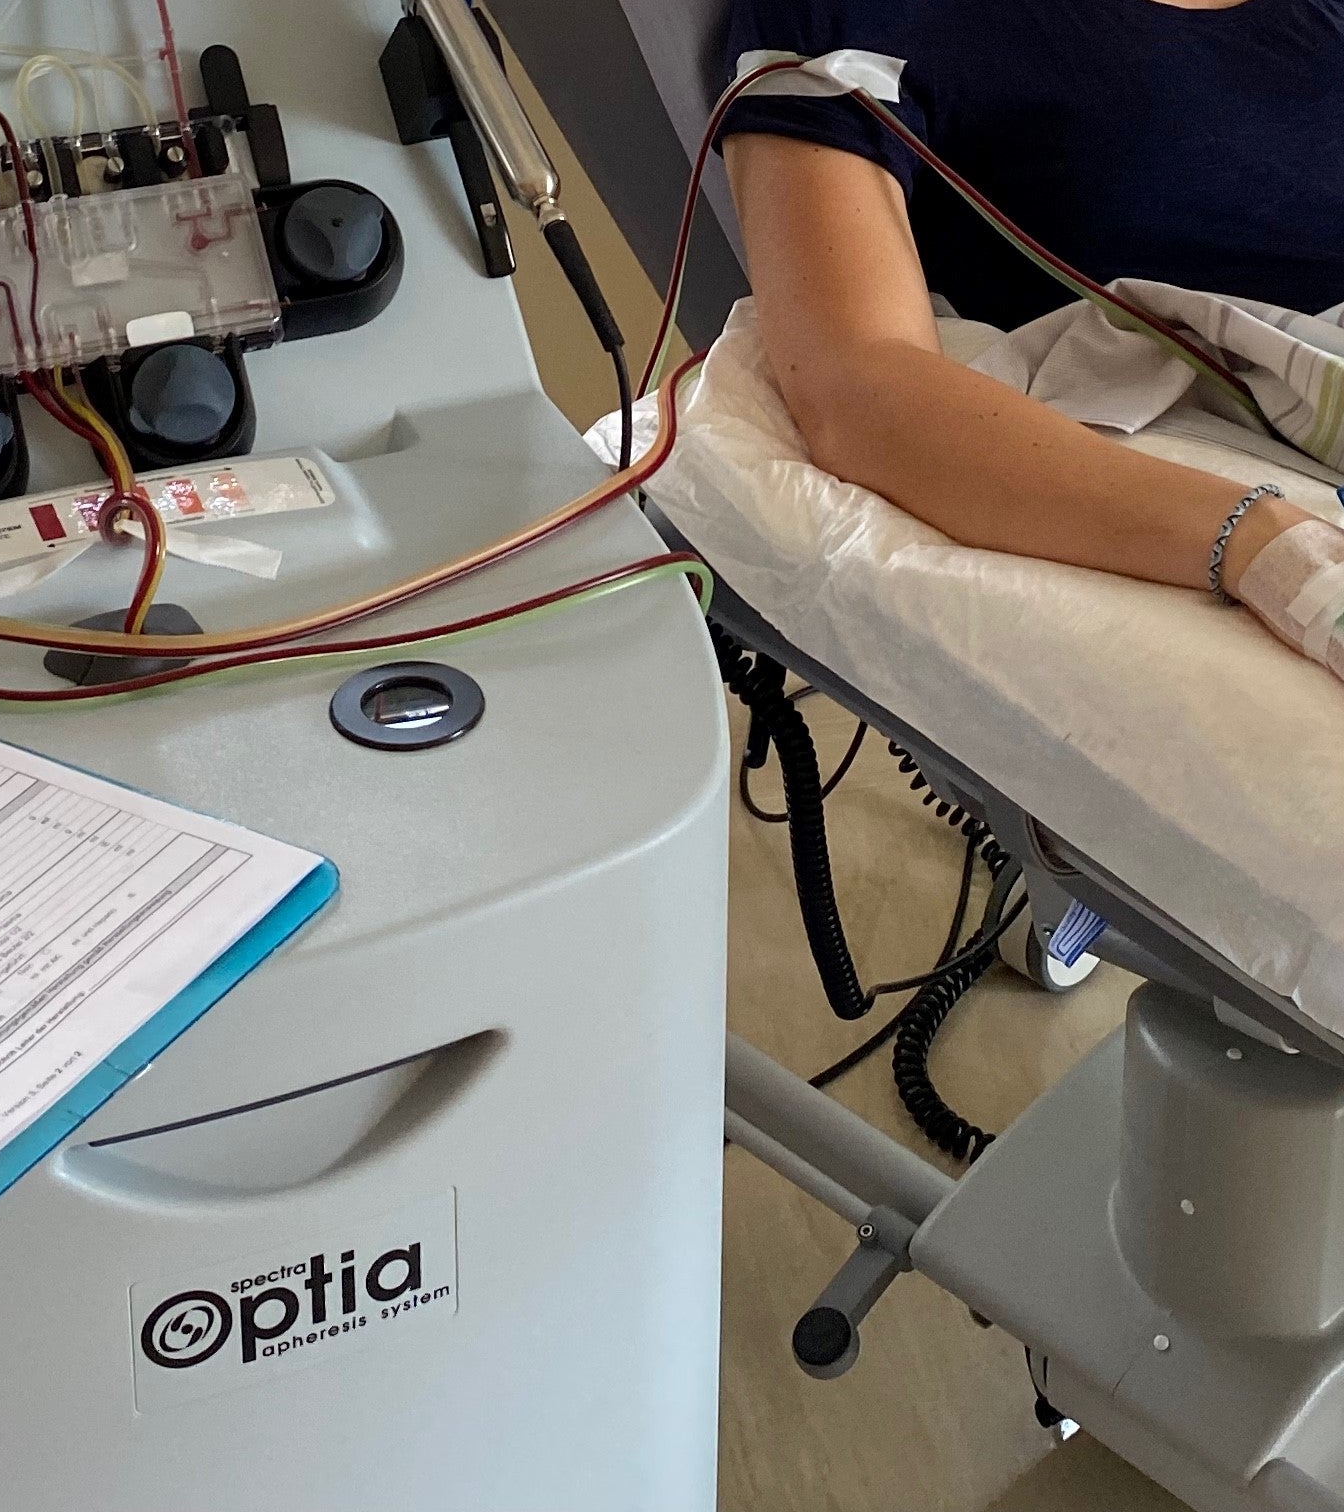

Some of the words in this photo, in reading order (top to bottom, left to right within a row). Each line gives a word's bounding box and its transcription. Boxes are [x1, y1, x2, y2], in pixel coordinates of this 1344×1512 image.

[2, 1096, 30, 1117] Version
[36, 1074, 57, 1089] Seite
[63, 1056, 77, 1068] von
[141, 1242, 423, 1369] Optia
[230, 1262, 307, 1294] spectra
[262, 1315, 367, 1358] apheresis
[380, 1284, 451, 1320] system
